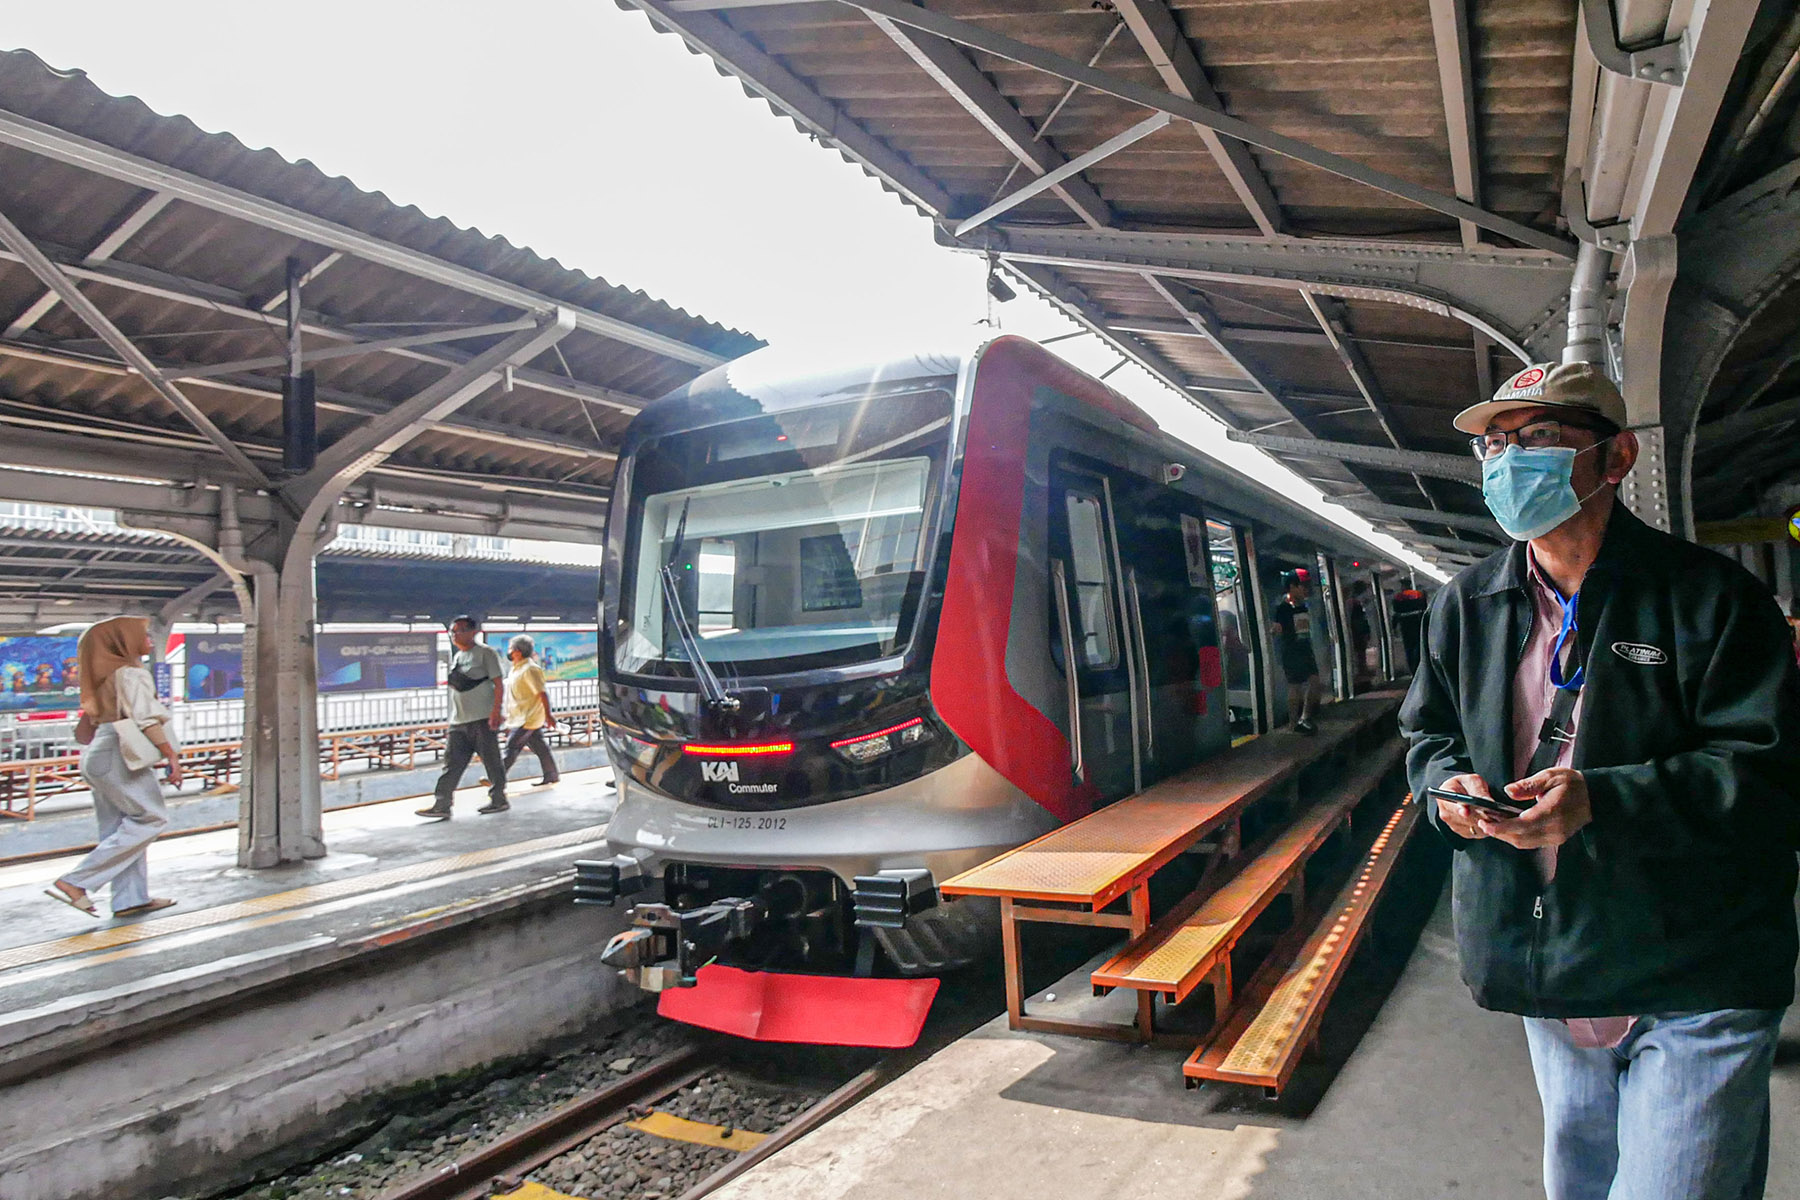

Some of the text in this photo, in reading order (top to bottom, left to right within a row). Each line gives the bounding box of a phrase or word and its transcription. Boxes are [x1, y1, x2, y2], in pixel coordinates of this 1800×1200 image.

[340, 645, 430, 656] OUT-OF-HOME
[701, 761, 740, 782] KAI
[728, 783, 778, 794] Commuter
